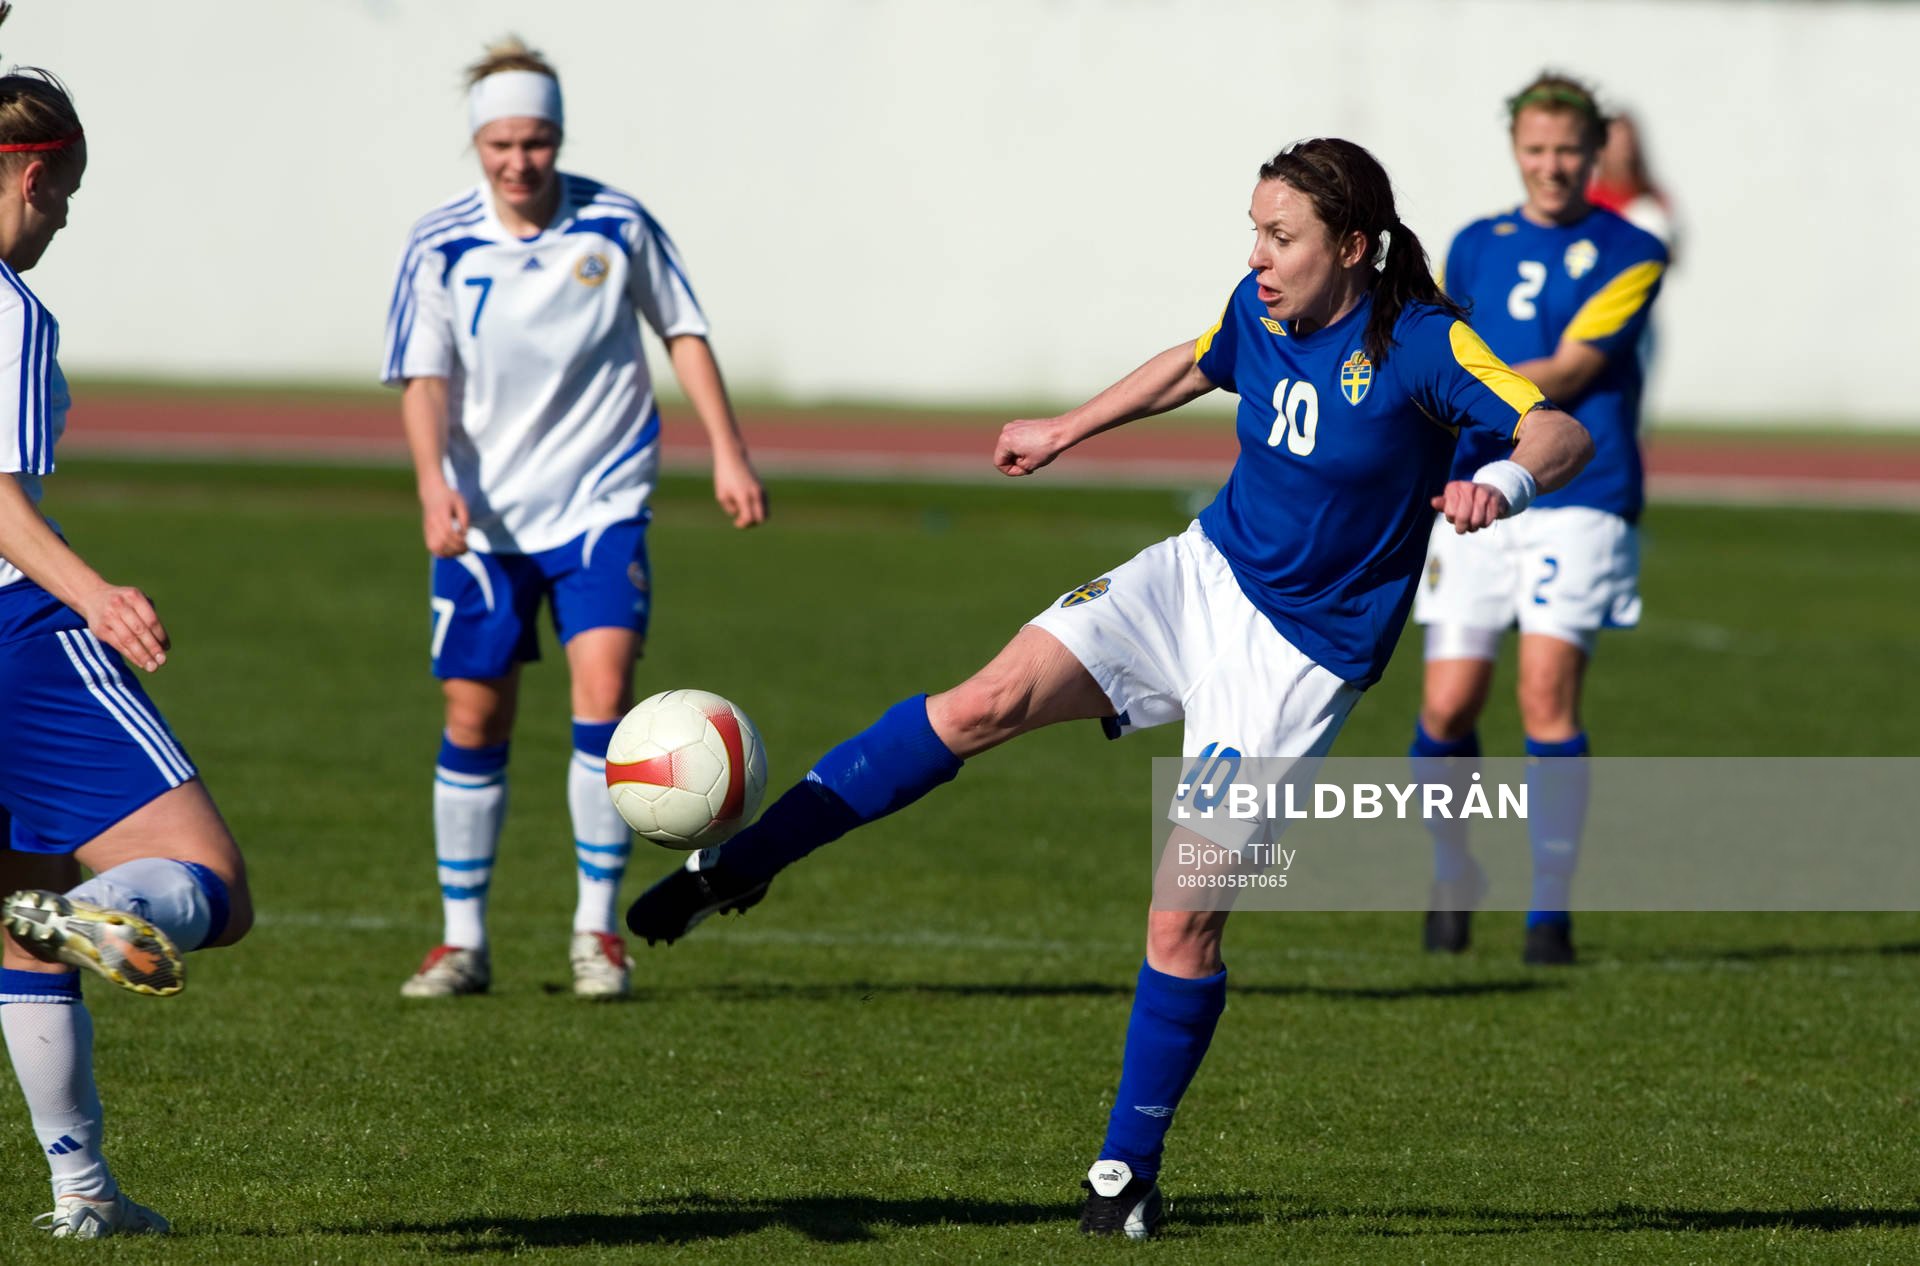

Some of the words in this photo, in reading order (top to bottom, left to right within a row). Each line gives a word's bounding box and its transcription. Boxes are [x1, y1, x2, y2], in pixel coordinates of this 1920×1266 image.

[464, 277, 494, 336] 7
[1507, 260, 1547, 321] 2
[1267, 378, 1319, 457] 10
[1533, 557, 1558, 605] 2
[431, 596, 456, 660] 7
[1176, 741, 1242, 813] 10
